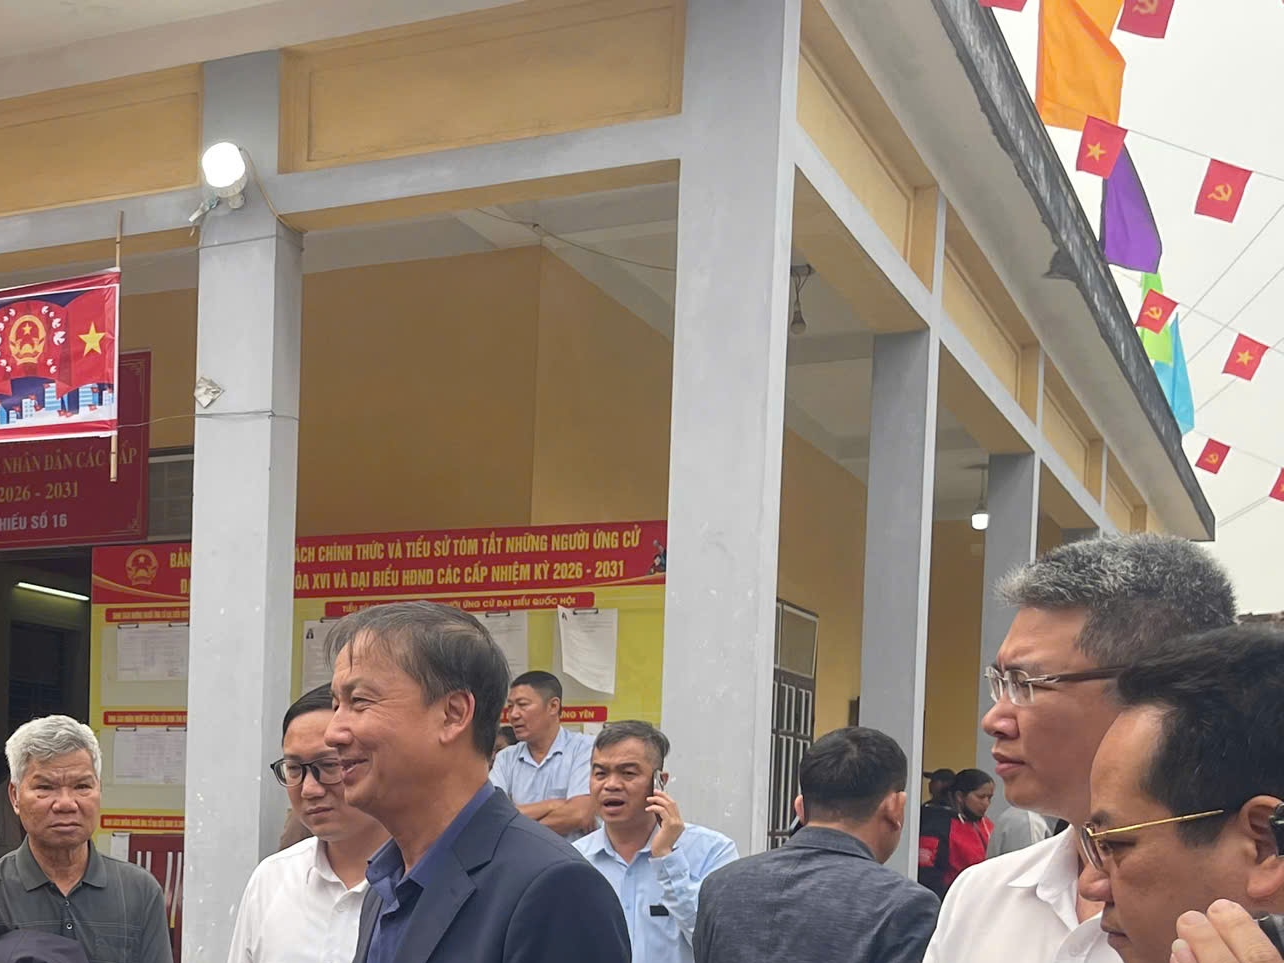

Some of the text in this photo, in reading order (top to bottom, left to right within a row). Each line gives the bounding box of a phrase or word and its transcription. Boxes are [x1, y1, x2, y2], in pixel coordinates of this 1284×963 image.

[3, 454, 41, 474] NHÂN
[76, 446, 105, 468] CÁC
[45, 481, 79, 499] 2031
[31, 511, 48, 528] SỐ
[51, 514, 67, 528] 16
[170, 547, 191, 568] BẢN
[295, 543, 315, 562] ÁCH
[318, 542, 352, 562] CHÍNH
[356, 540, 384, 560] THỨC
[388, 538, 402, 559] VÀ
[406, 535, 430, 557] TIỂU
[434, 534, 451, 556] SỬ
[453, 536, 477, 556] TÓM
[505, 533, 548, 553] NHỮNG
[551, 529, 589, 550] NGƯỜI
[593, 528, 619, 549] ỨNG
[623, 524, 641, 547] CỬ
[295, 570, 309, 590] ÓA
[313, 573, 330, 589] XVI
[333, 569, 348, 588] VÀ
[373, 564, 399, 587] BIỂU
[437, 564, 461, 584] CÁC
[464, 561, 488, 583] CẤP
[491, 561, 531, 585] NHIỆM
[534, 560, 549, 579] KỲ
[553, 562, 583, 579] 2026
[595, 560, 624, 578] 2031
